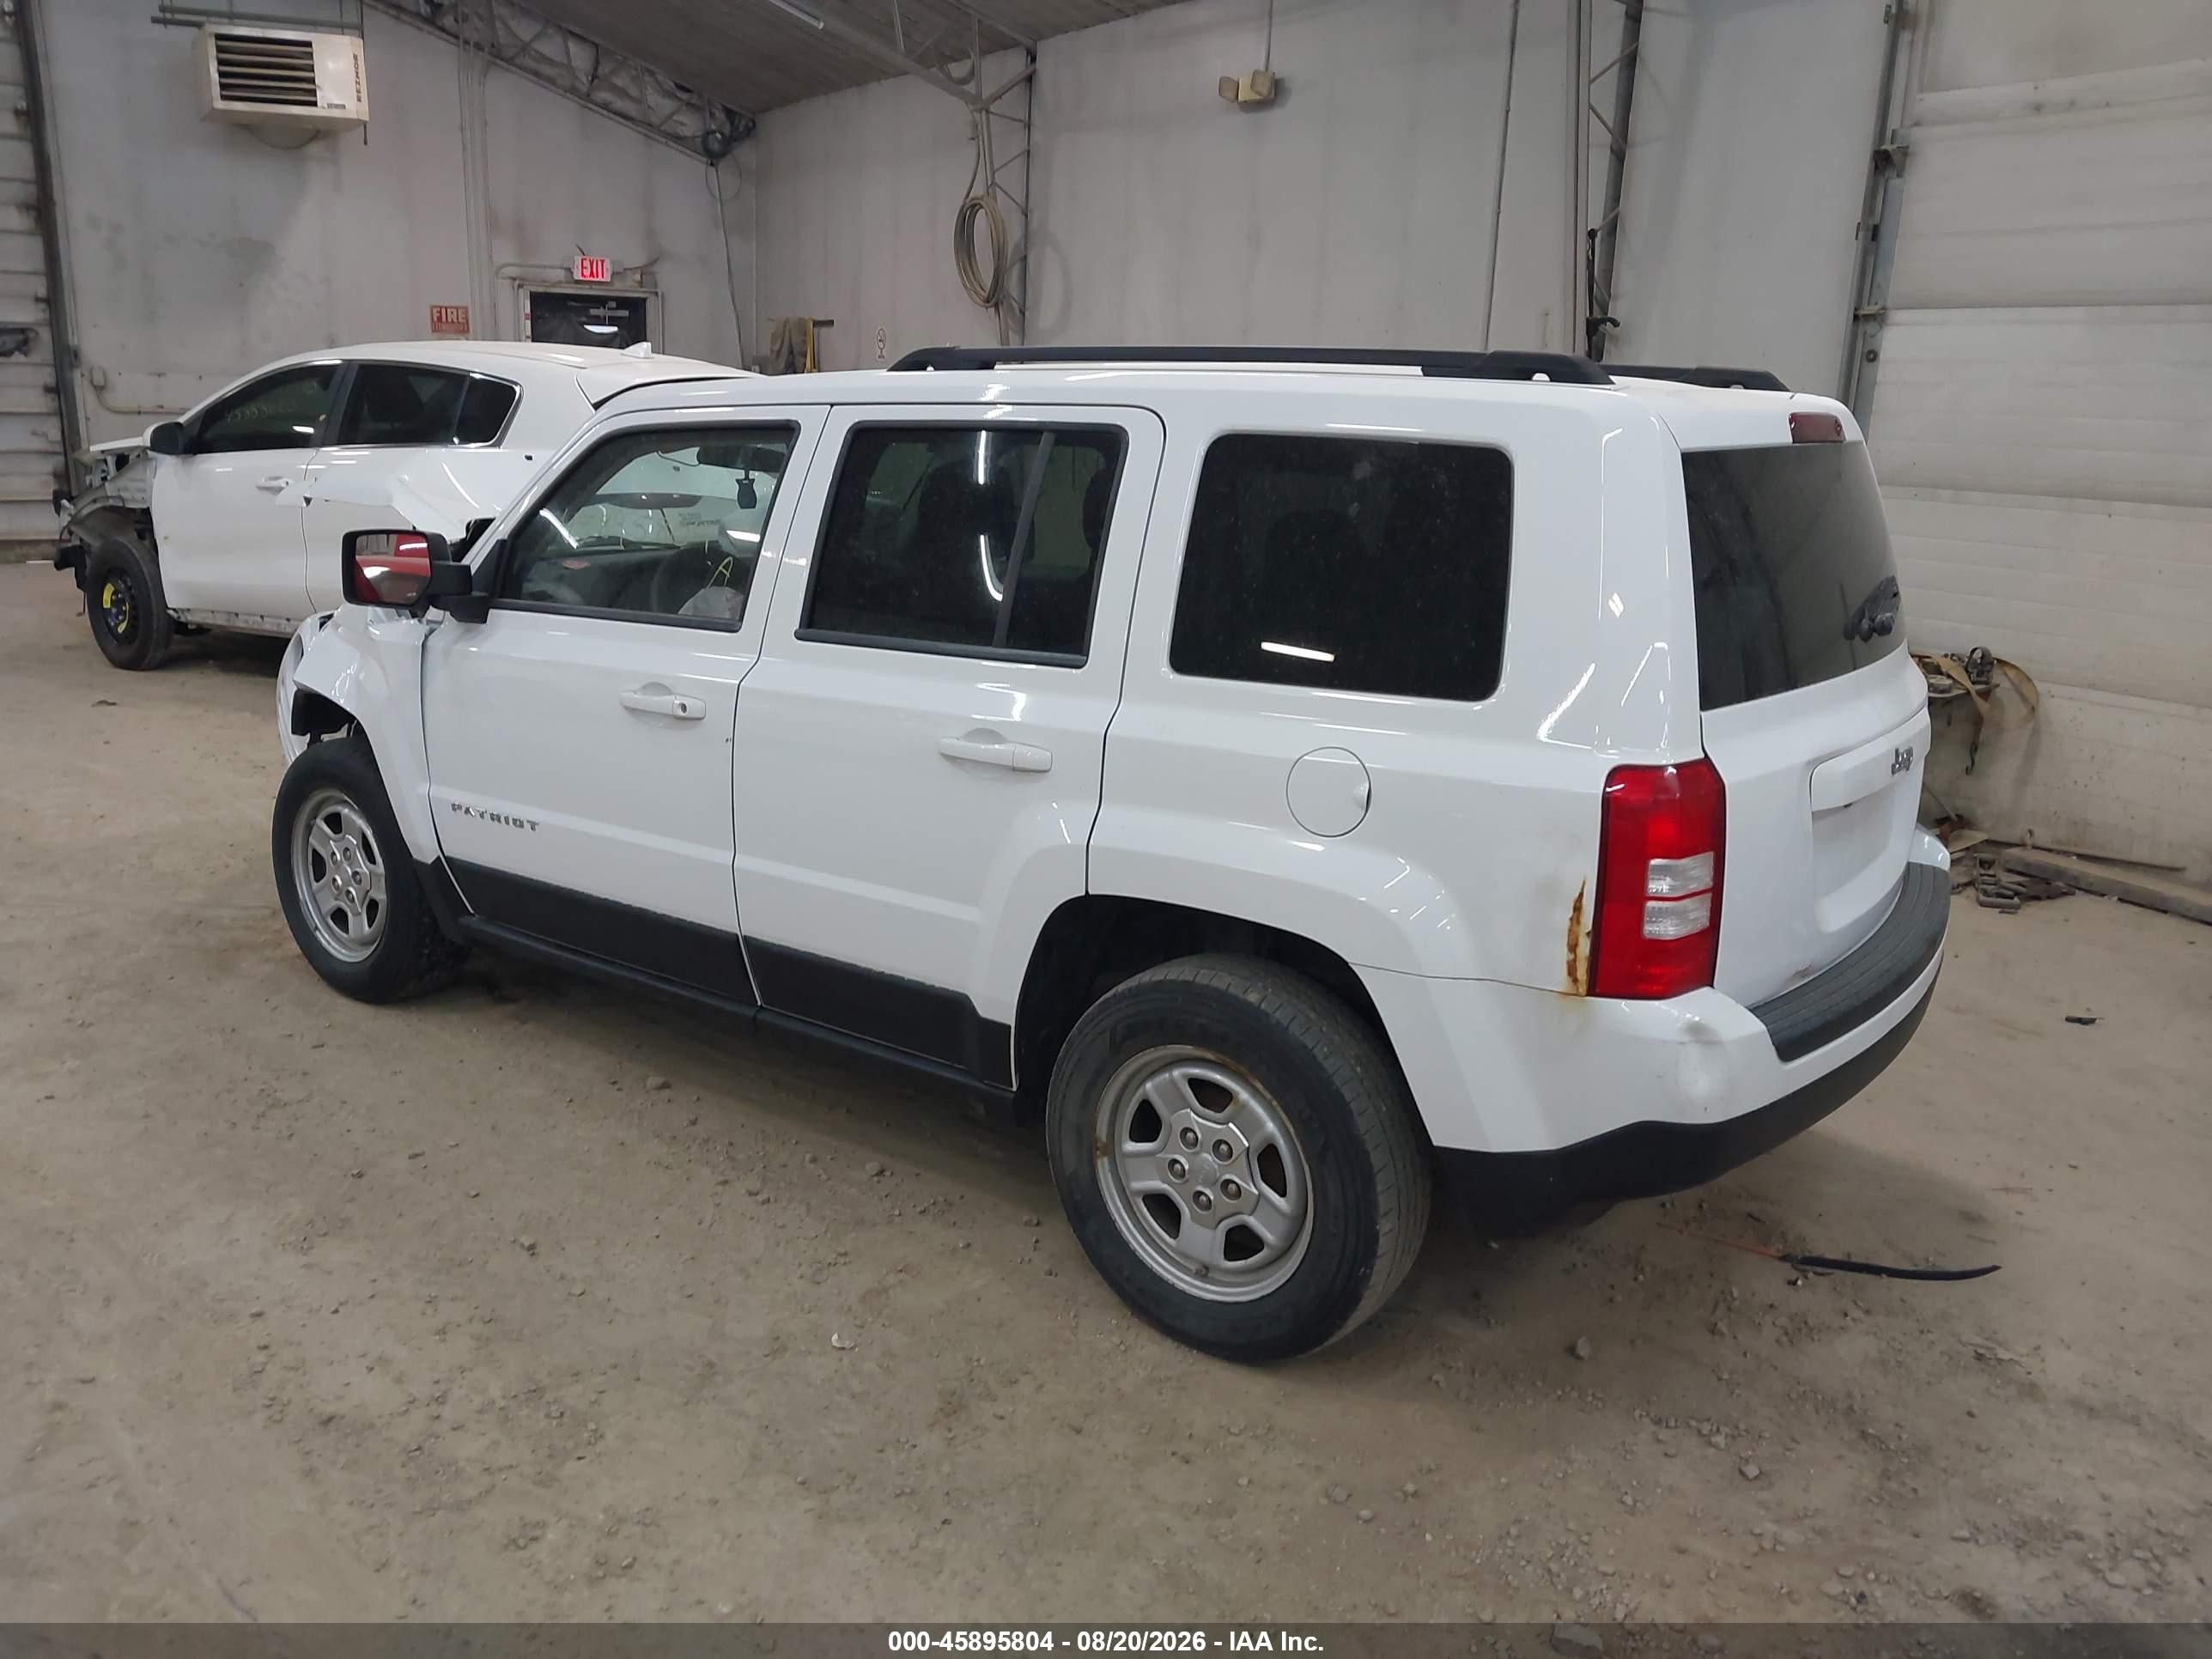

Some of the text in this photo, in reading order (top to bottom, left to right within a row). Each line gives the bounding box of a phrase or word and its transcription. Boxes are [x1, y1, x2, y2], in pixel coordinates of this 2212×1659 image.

[580, 258, 605, 279] EXIT
[432, 307, 468, 324] FIRE
[451, 803, 539, 832] PATRIOT
